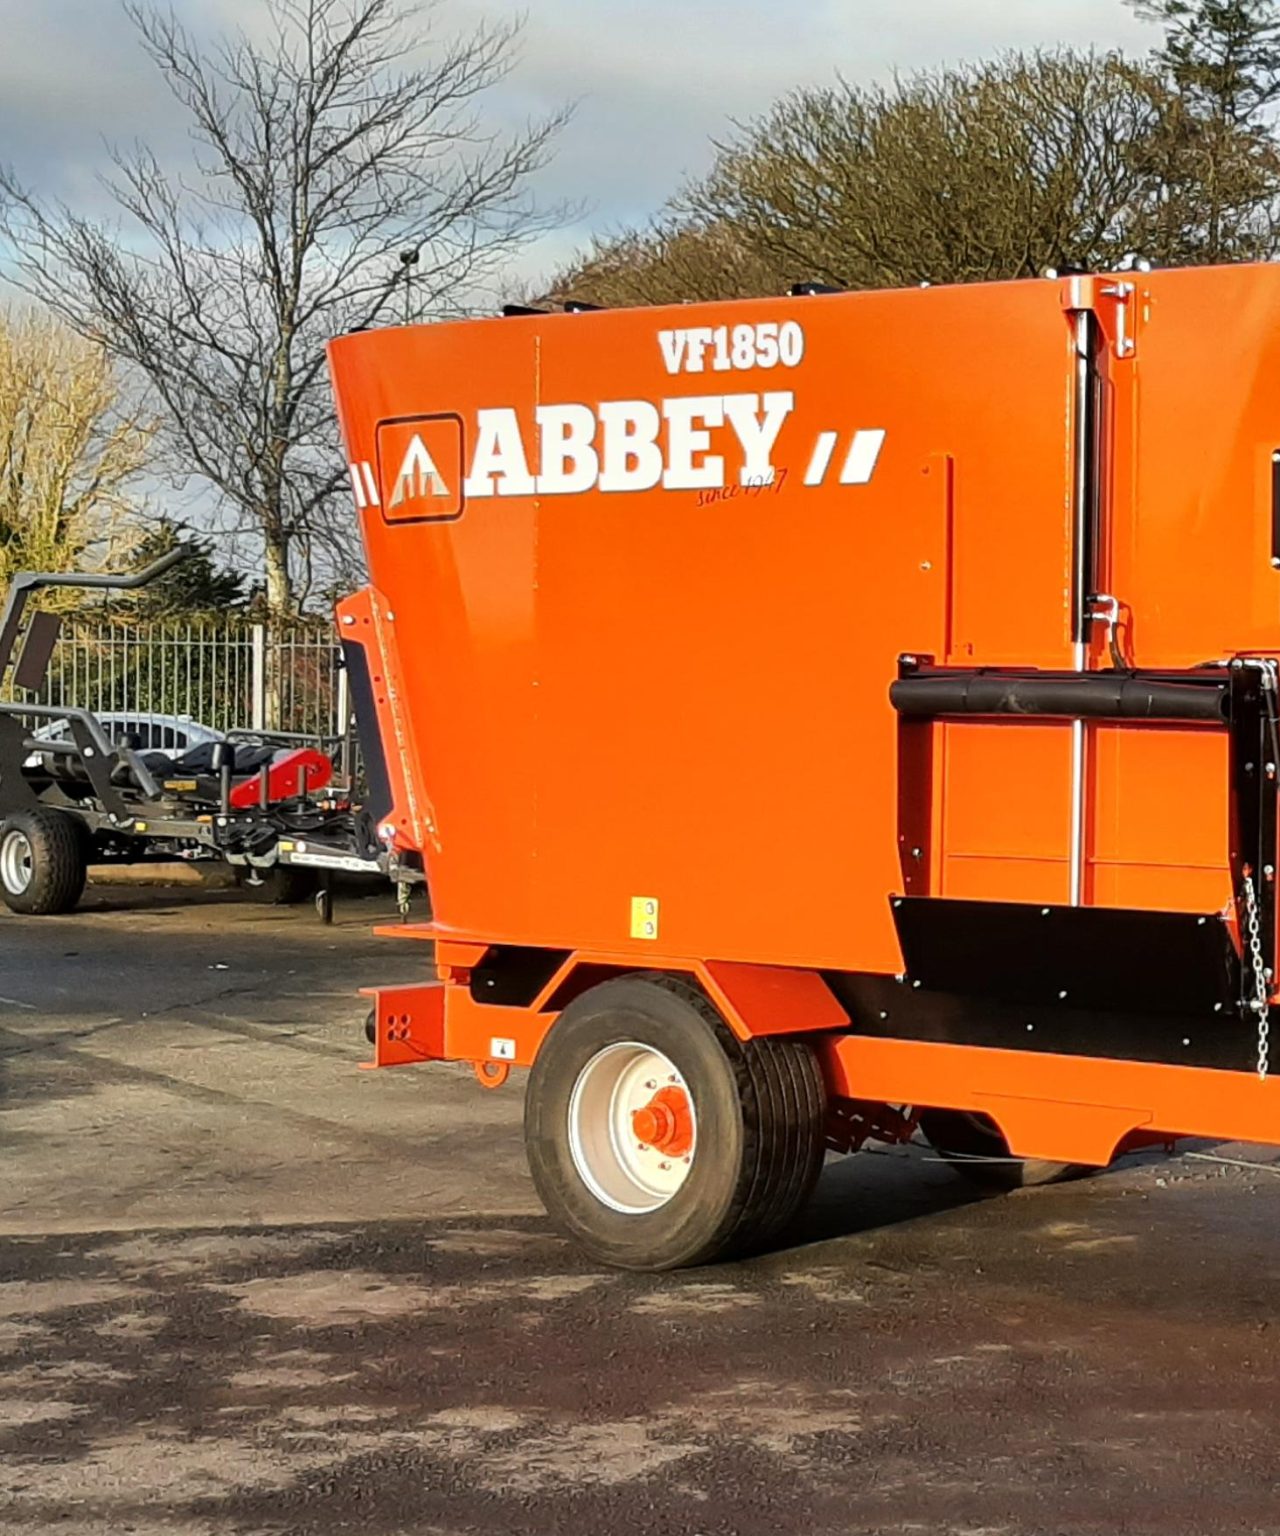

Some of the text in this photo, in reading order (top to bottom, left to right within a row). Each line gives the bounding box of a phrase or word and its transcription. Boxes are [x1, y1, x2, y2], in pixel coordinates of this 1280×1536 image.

[657, 320, 804, 375] VF1850
[464, 391, 794, 498] ABBEY
[696, 484, 738, 507] since
